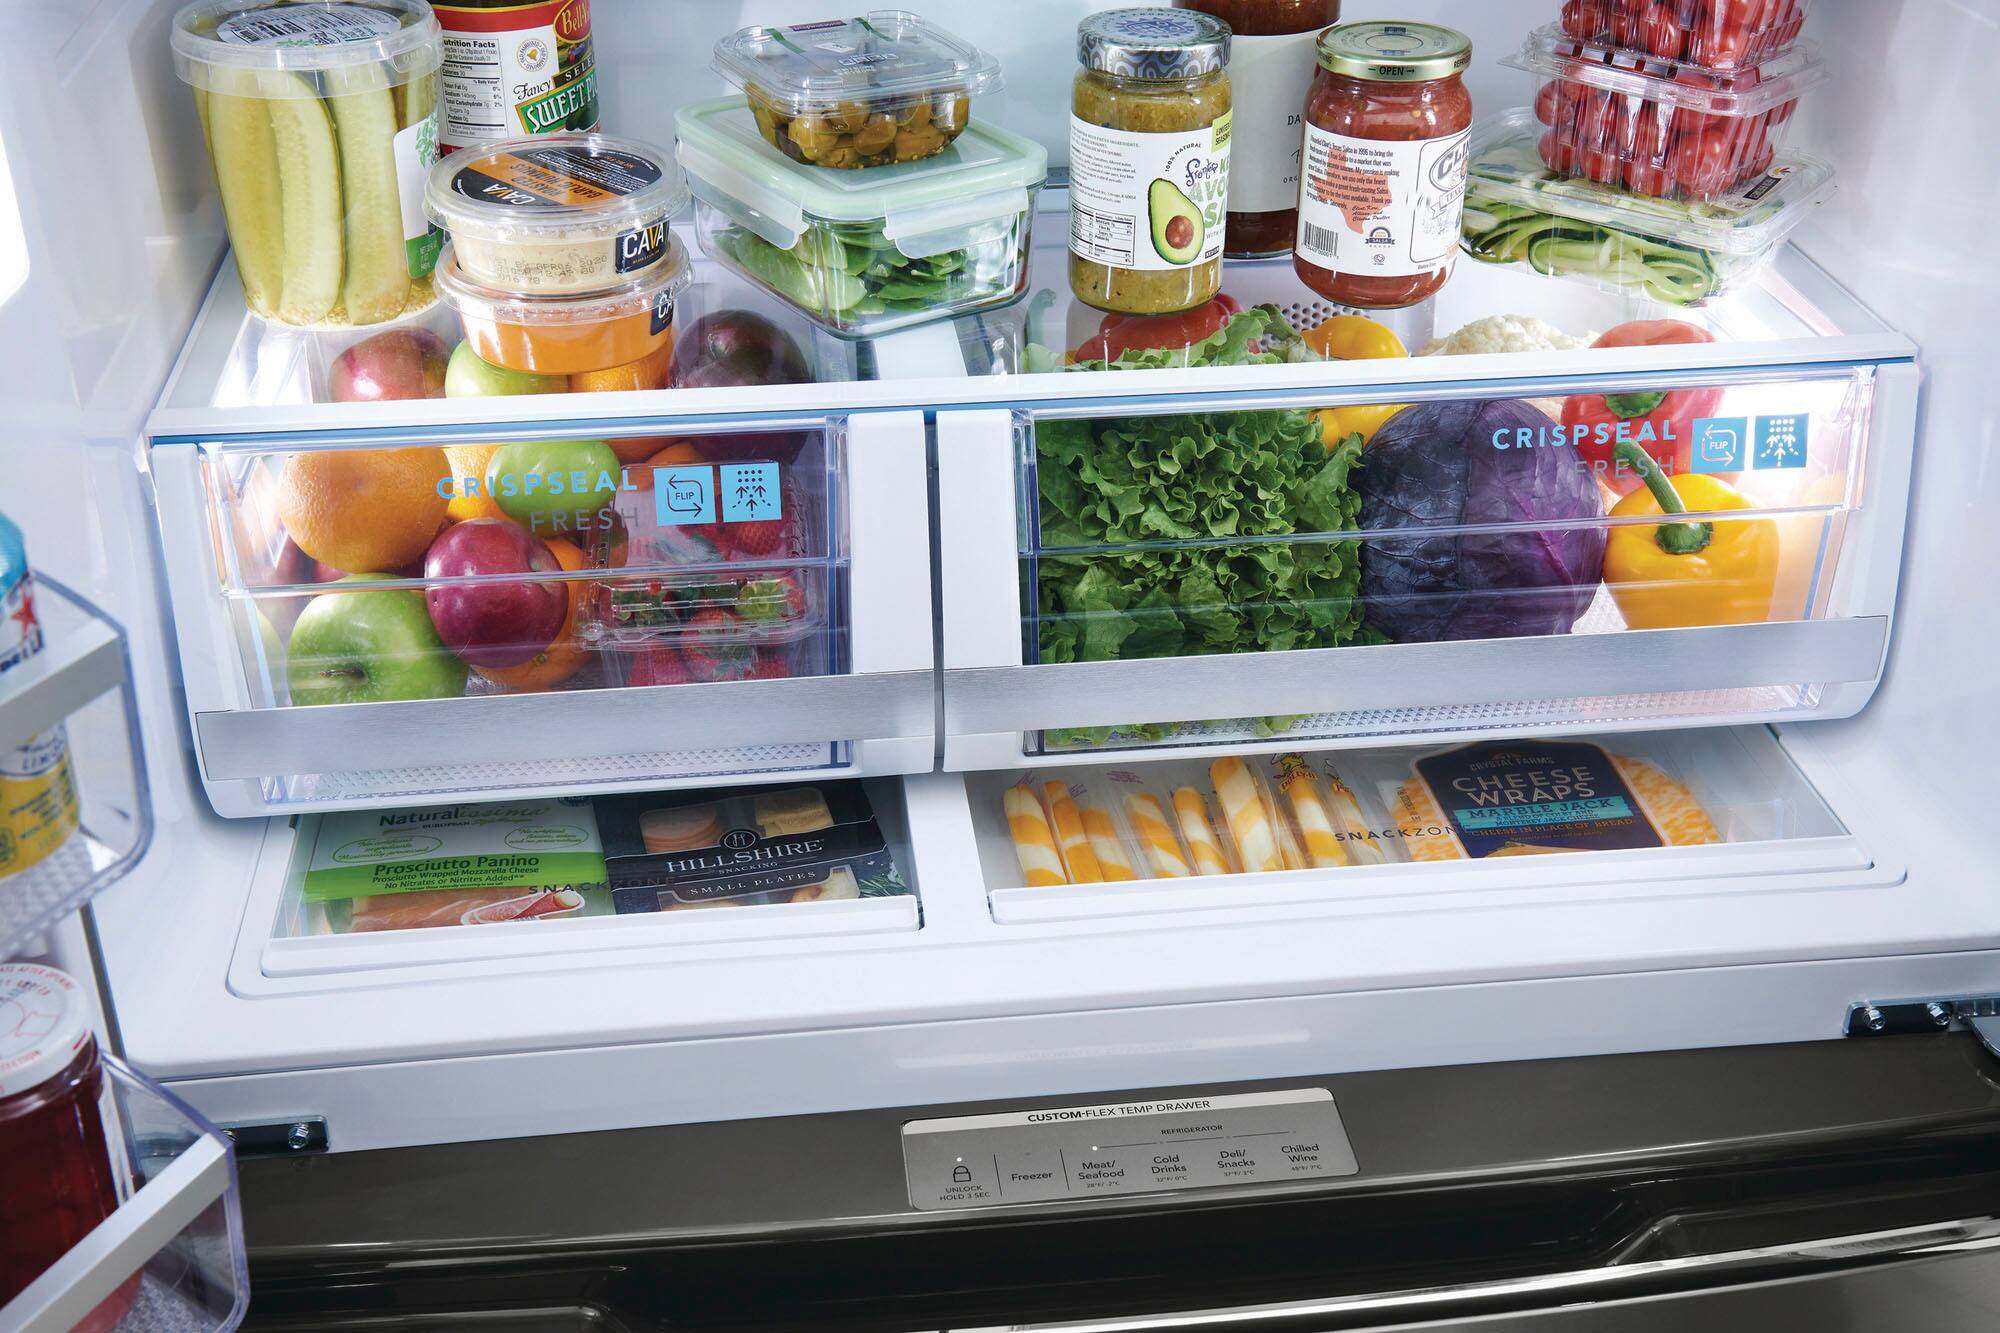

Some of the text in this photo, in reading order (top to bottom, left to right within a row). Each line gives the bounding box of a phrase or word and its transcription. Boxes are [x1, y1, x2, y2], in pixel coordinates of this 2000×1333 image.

[1379, 66, 1404, 76] OPEN
[513, 79, 551, 100] Fancy
[527, 83, 585, 134] SWEET
[1288, 114, 1301, 126] DA
[1174, 143, 1202, 156] NATURAL
[482, 183, 535, 205] CAVA
[560, 181, 603, 199] GARLIC
[623, 222, 664, 258] CAVA
[1493, 419, 1677, 450] CRISPSEAL
[1710, 440, 1729, 451] FLIP
[1575, 455, 1675, 481] FRESH
[437, 469, 637, 499] CRISPSEAL
[675, 491, 694, 501] FLIP
[531, 507, 639, 532] FRESH
[1470, 756, 1554, 771] CRYSTAL FARMS
[1452, 766, 1595, 792] CHEESE
[1467, 782, 1595, 807] WRAPS
[1469, 798, 1614, 819] MARBLE JACK
[1472, 828, 1518, 837] CHEESE
[1536, 822, 1573, 832] PLACE
[1595, 819, 1634, 827] BREAD
[1496, 818, 1542, 826] MONTEREY
[667, 840, 823, 873] HILLSHIRE
[374, 855, 539, 876] Prosciutto Panino
[718, 862, 778, 874] SNACKING
[372, 874, 416, 884] Prosciutto
[420, 870, 458, 880] Wrapped
[462, 867, 506, 875] Mozzarella
[400, 879, 435, 888] Nitrates
[690, 871, 816, 895] SMALL PLATES
[1028, 1100, 1210, 1122] CUSTOM-FLEX TEMP DRAWER
[1160, 1125, 1224, 1136] REFRIGERATOR
[1220, 1149, 1246, 1158] Deli/
[1281, 1144, 1320, 1154] Chilled
[1082, 1160, 1116, 1170] Meat/
[1154, 1154, 1180, 1164] Cold
[1218, 1158, 1256, 1168] Snacks
[1288, 1154, 1318, 1163] Wine
[1078, 1170, 1125, 1180] Seafood
[1151, 1164, 1187, 1174] Drinks
[1012, 1172, 1053, 1181] Freezer
[946, 1185, 982, 1193] UNLOCK
